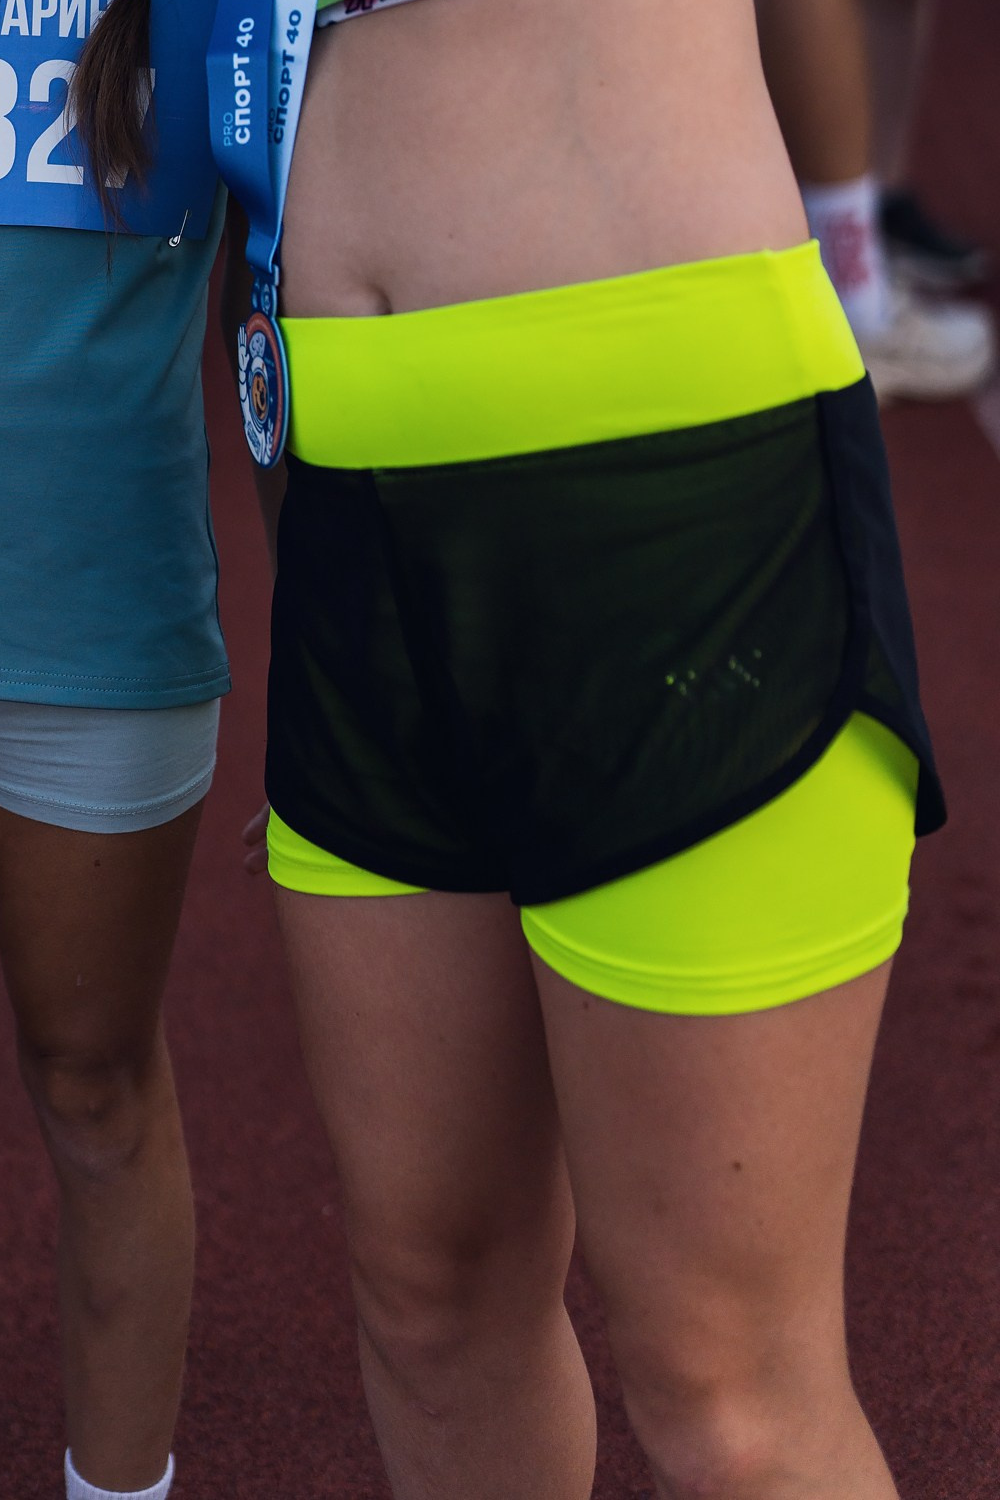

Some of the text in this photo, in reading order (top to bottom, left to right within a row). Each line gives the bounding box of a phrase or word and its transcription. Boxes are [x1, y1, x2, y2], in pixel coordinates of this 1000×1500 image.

[222, 111, 234, 147] PRO
[233, 17, 255, 145] СПОРТ 40
[273, 9, 303, 145] СПОРТ 40
